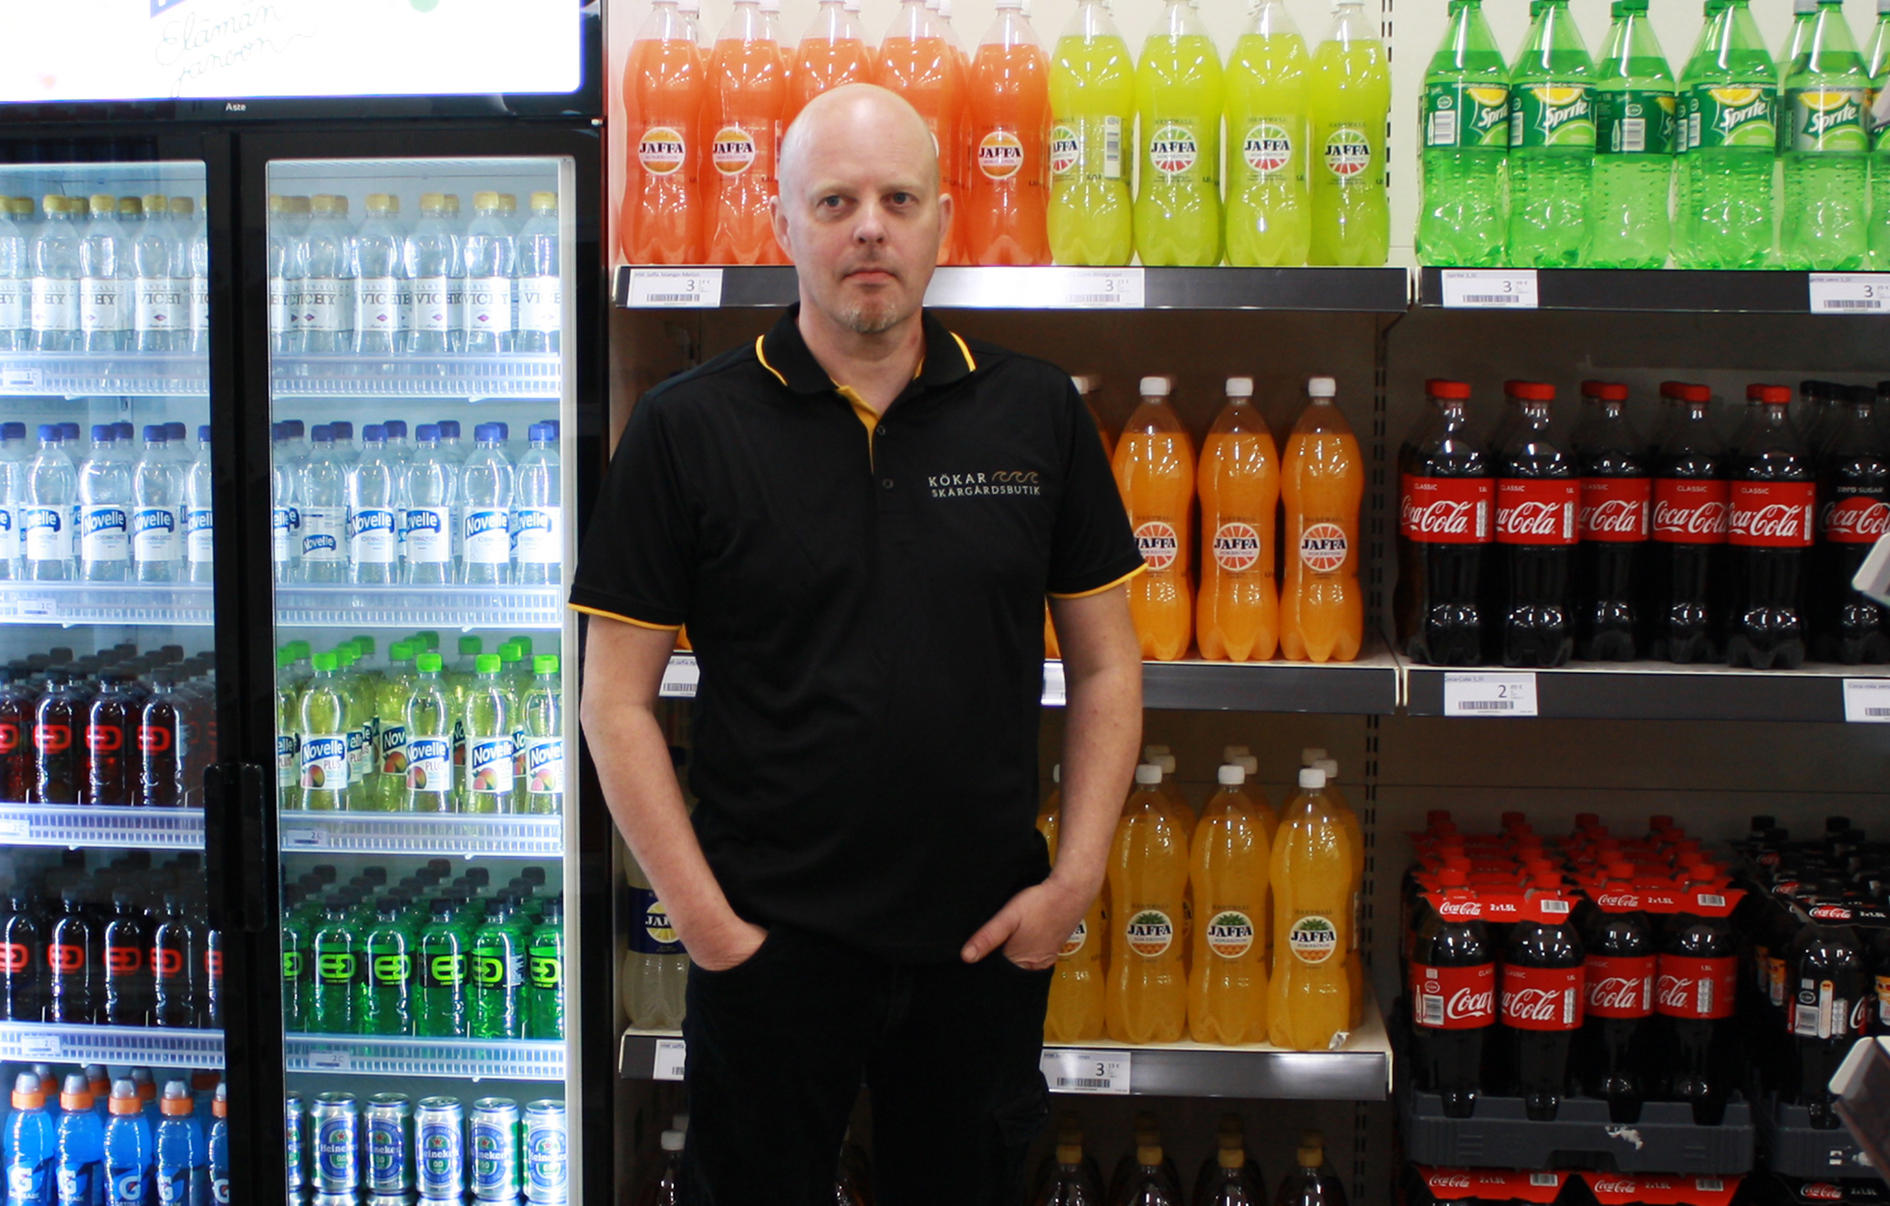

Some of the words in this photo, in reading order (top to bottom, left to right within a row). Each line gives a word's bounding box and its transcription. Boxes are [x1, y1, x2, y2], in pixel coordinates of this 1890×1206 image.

[225, 102, 246, 112] Aste
[1543, 100, 1589, 127] Sprite
[1720, 100, 1768, 128] Sprite
[1808, 104, 1858, 133] Sprite
[640, 143, 684, 153] JAFFA
[713, 143, 753, 153] JAFFA
[1151, 142, 1196, 153] JAFFA
[1245, 140, 1290, 151] JAFFA
[1325, 145, 1370, 155] JAFFA
[979, 147, 1021, 158] JAFFA
[686, 280, 695, 292] 3
[1105, 279, 1114, 292] 3
[1502, 281, 1512, 293] 3
[1863, 285, 1873, 298] 3
[928, 473, 986, 487] KÖKAR
[1676, 485, 1708, 493] CLASSIC
[85, 511, 124, 534] Novelle
[466, 513, 508, 536] Novelle
[1214, 538, 1258, 549] JAFFA
[1301, 539, 1346, 550] JAFFA
[1498, 684, 1507, 698] 2
[303, 741, 343, 761] Novelle
[1128, 924, 1172, 936] JAFFA
[1208, 925, 1252, 937] JAFFA
[1291, 930, 1335, 942] JAFFA
[319, 954, 356, 978] ED
[1096, 1063, 1104, 1076] 3
[119, 1175, 141, 1200] G
